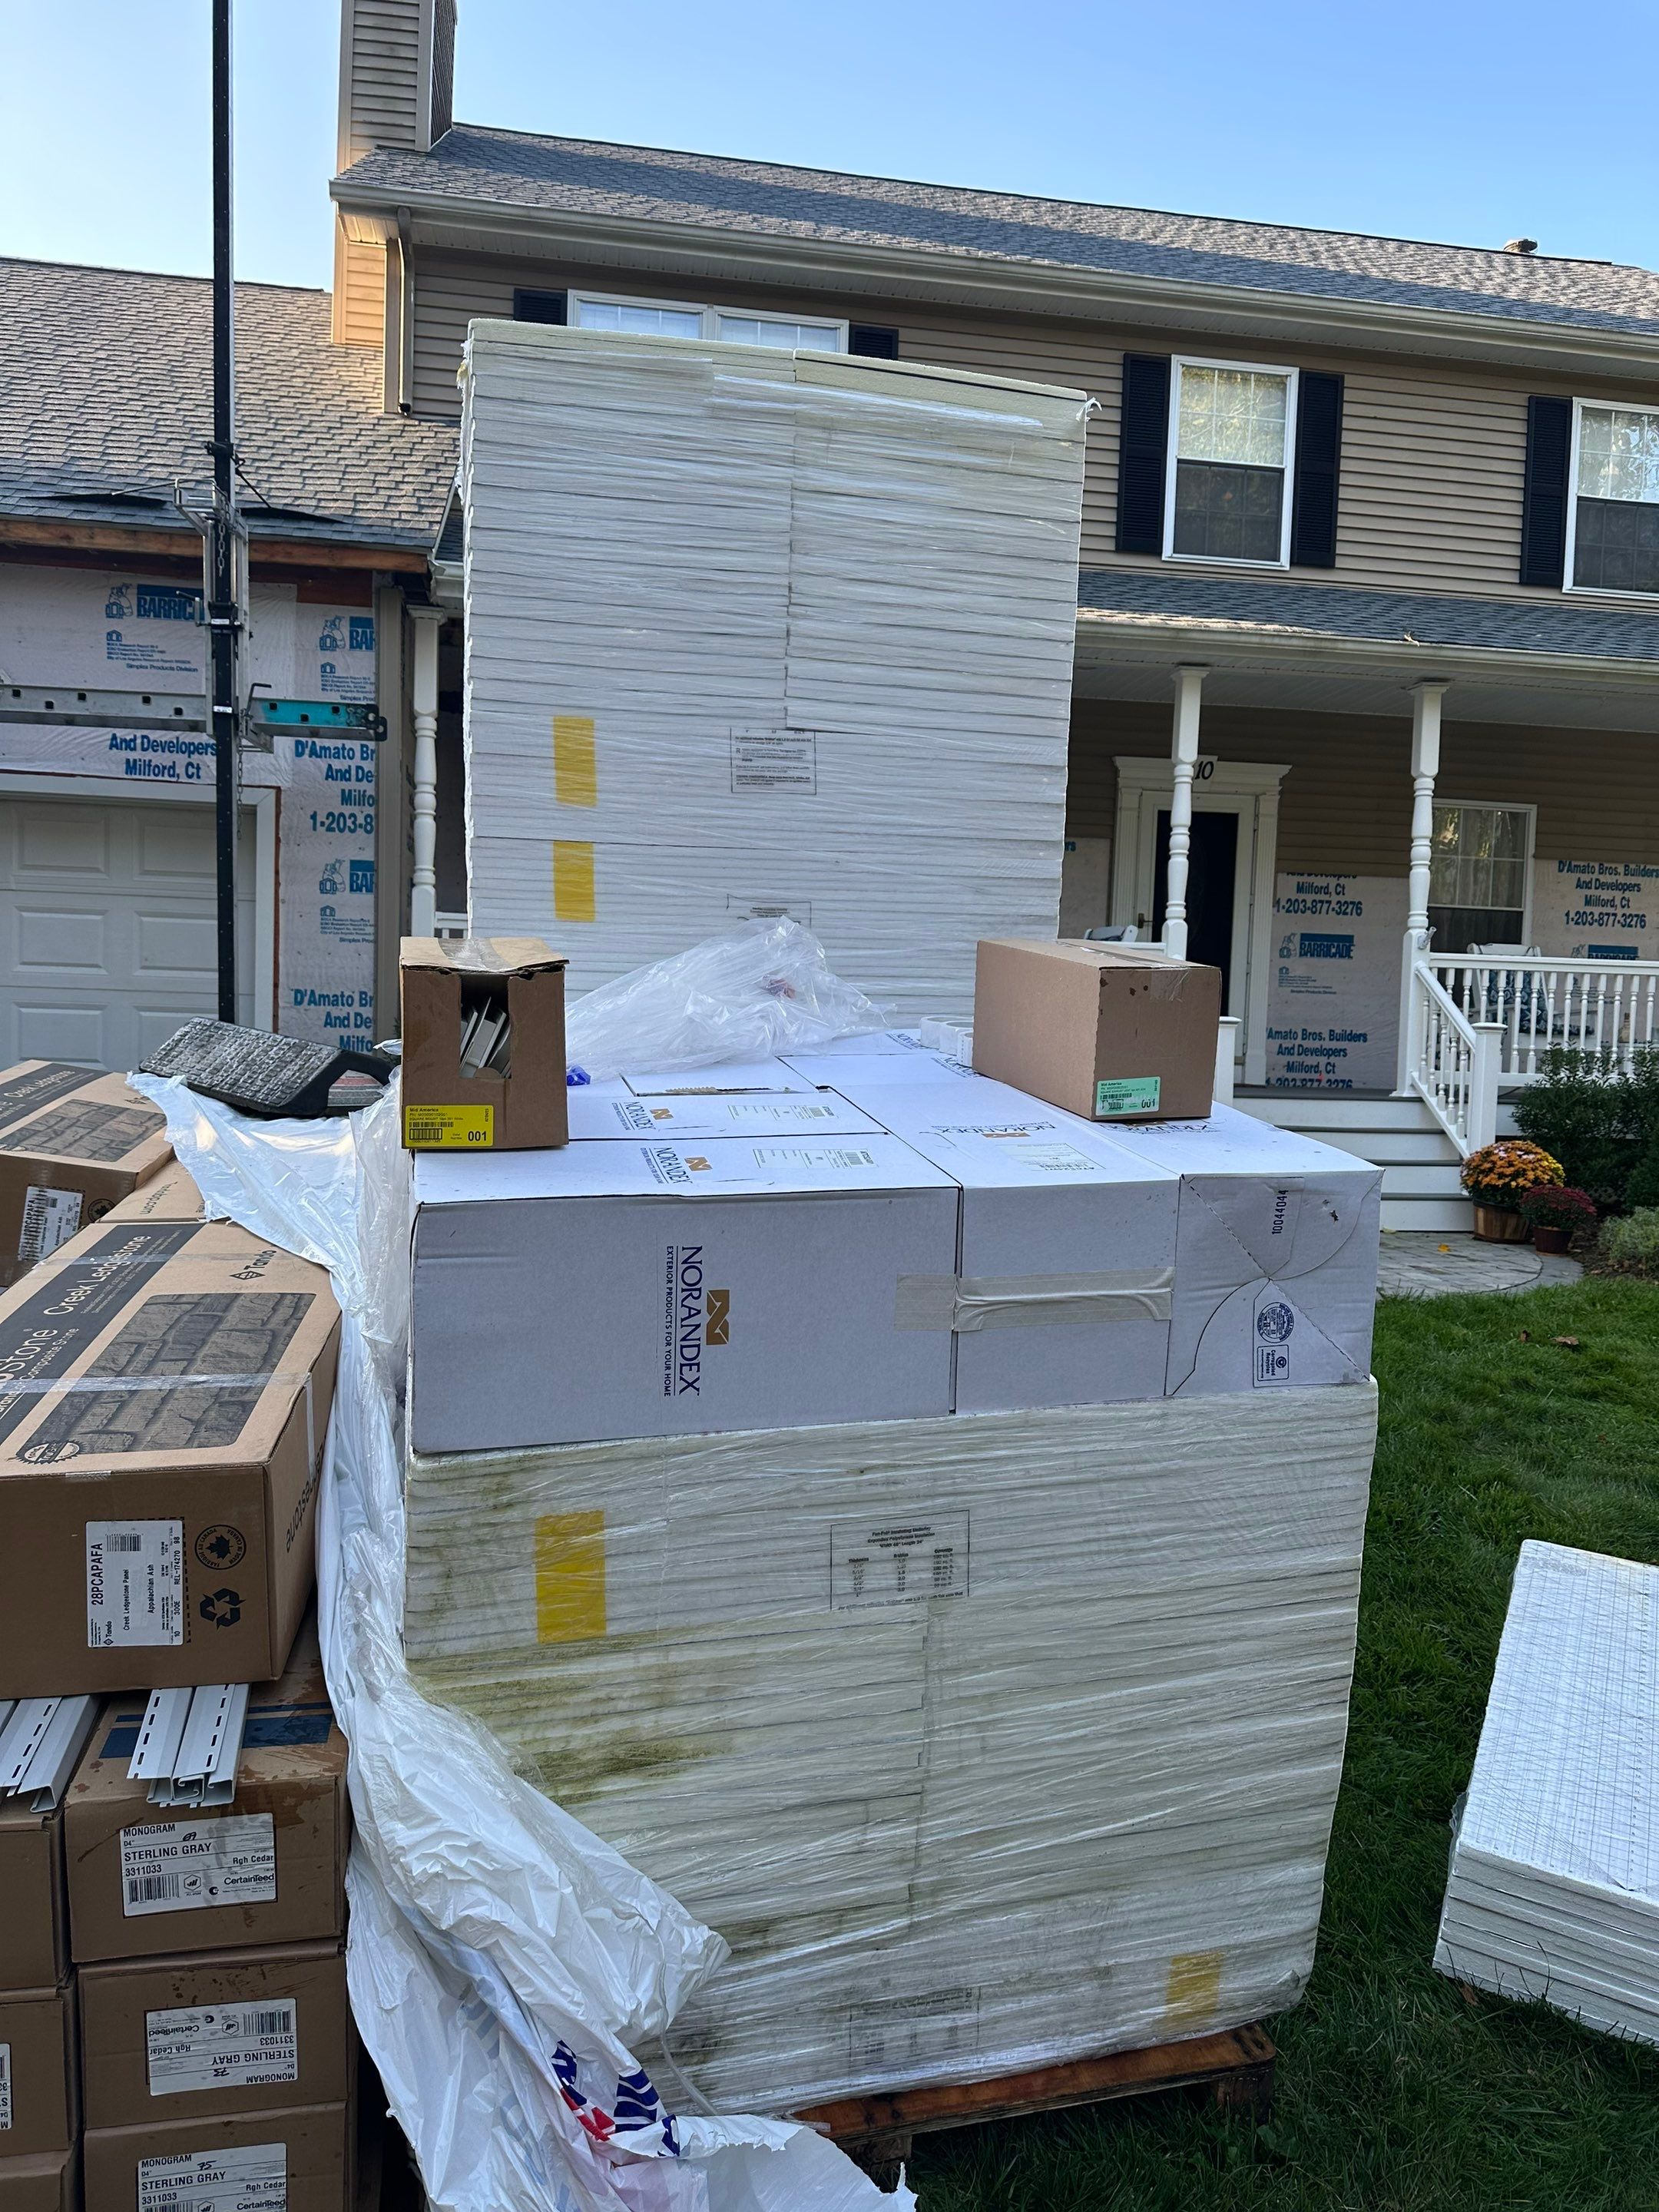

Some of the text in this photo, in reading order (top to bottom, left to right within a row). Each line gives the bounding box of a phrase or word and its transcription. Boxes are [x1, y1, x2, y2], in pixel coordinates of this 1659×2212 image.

[109, 733, 217, 758] And Developers
[295, 740, 356, 760] D'Amato
[125, 758, 201, 781] Milford, Ct
[325, 763, 352, 782] And
[1194, 760, 1214, 780] 10
[310, 811, 374, 834] 1-203-8
[1558, 860, 1659, 878] D'Amato Bros. Builders
[1296, 882, 1346, 897] Milford, Ct
[1575, 877, 1641, 894] And Developers
[1276, 898, 1363, 916] 1-203-877-3276
[1584, 894, 1631, 910] Milford, Ct
[1565, 910, 1647, 929] 1-203-877-3276
[1299, 941, 1356, 959] BARRICADE
[293, 988, 354, 1008] D'Amato
[324, 1011, 350, 1028] And
[1301, 1028, 1326, 1041] Bros.
[1329, 1029, 1368, 1042] Builders
[1277, 1044, 1347, 1060] And Developers
[1286, 1061, 1336, 1076] Milford, Ct
[468, 1131, 487, 1142] 001
[937, 1124, 1056, 1134] NORANDEX
[654, 1147, 693, 1184] NORANDEX
[1272, 1190, 1289, 1234] 10044044
[243, 1250, 276, 1270] Tando
[43, 1283, 98, 1316] Creek
[77, 1235, 152, 1283] Ledgestone
[665, 1286, 674, 1330] PRODUCTS
[679, 1245, 703, 1396] NORANDEX
[19, 1346, 62, 1380] Composite
[52, 1328, 79, 1346] Stone
[664, 1348, 673, 1371] YOUR
[200, 1528, 217, 1542] CANADA
[227, 1529, 243, 1545] CANADA
[91, 1543, 104, 1605] 28PCAPAFA
[124, 1823, 176, 1837] MONOGRAM
[124, 1843, 212, 1862] STERLING GRAY
[233, 1854, 273, 1866] Rgh Cedar
[125, 1864, 162, 1877] 3311033
[224, 1873, 274, 1886] CertainTeed
[148, 2025, 200, 2038] CertainTeed
[260, 2035, 294, 2045] 3311033
[150, 2045, 191, 2055] Rgh Cedar
[211, 2049, 295, 2066] STERLING GRAY
[246, 2071, 295, 2084] MONOGRAM
[141, 2154, 192, 2168] MONOGRAM
[197, 2160, 217, 2171] 75
[141, 2171, 227, 2191] STERLING GRAY
[246, 2181, 286, 2192] Rgh Cedar
[142, 2192, 177, 2205] 3311033
[237, 2199, 286, 2210] CertainTeed
